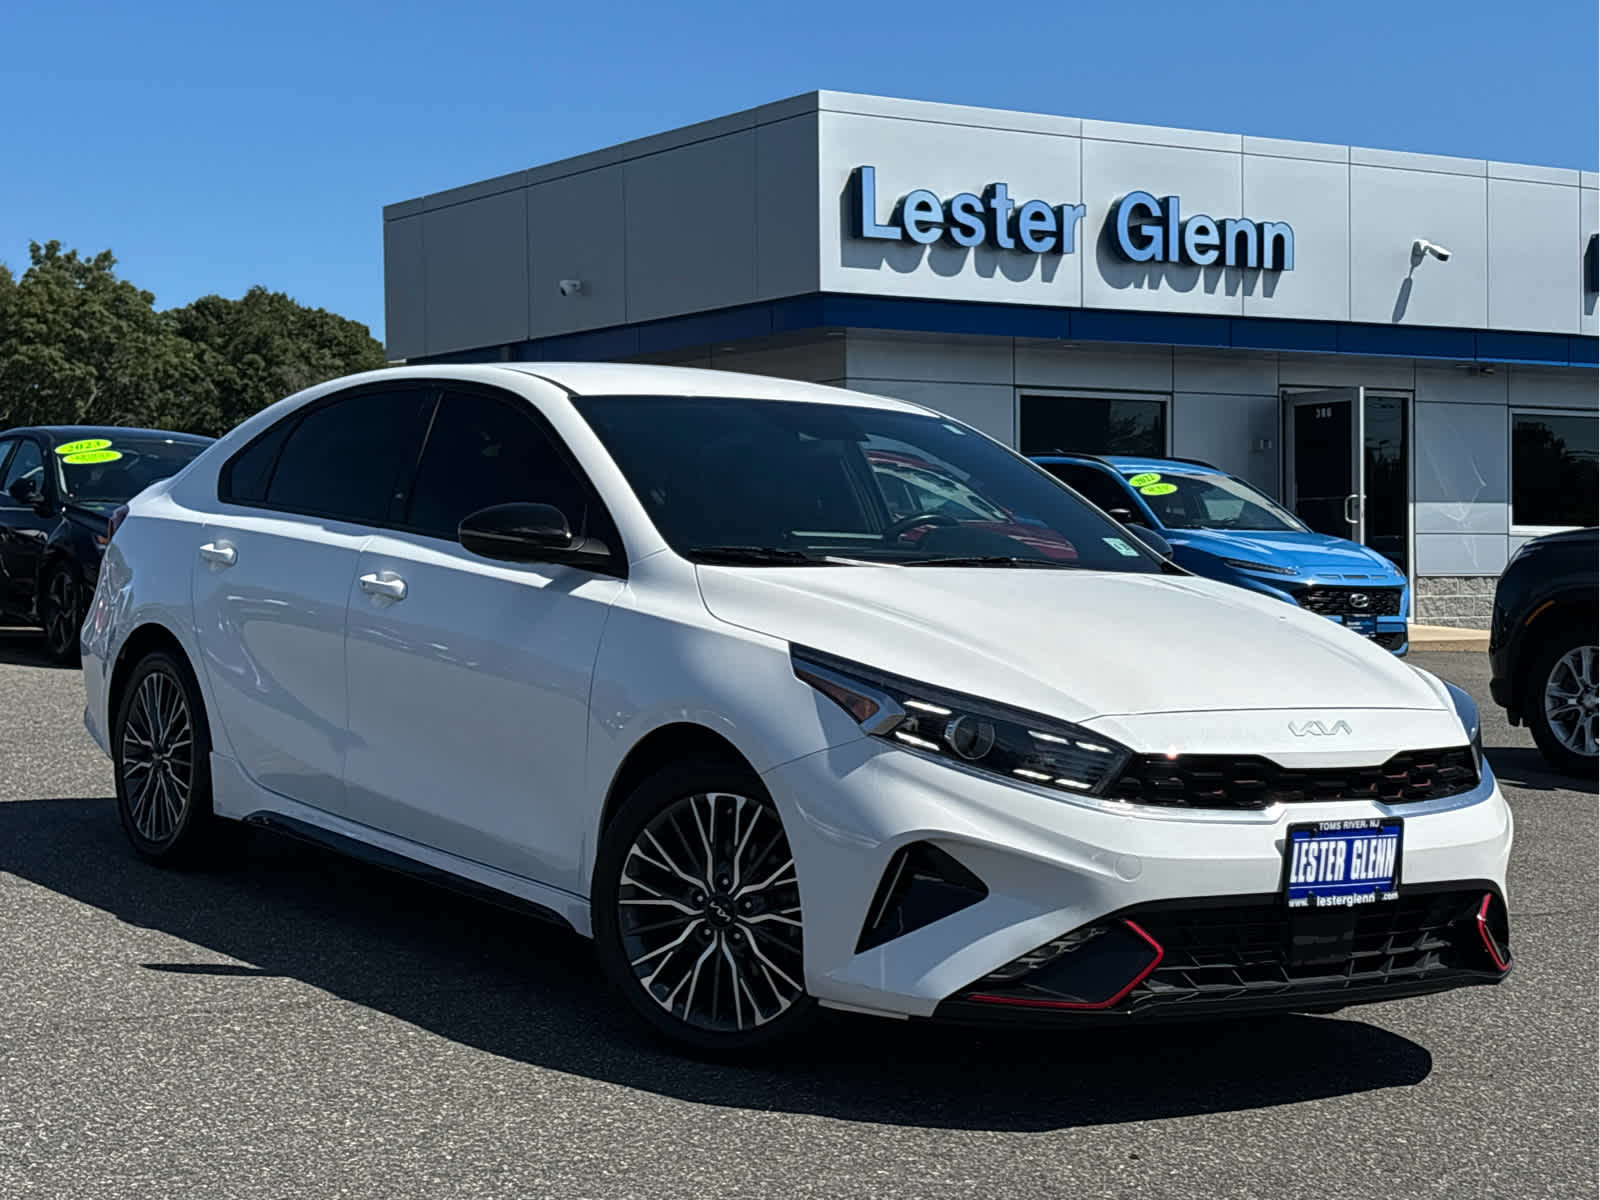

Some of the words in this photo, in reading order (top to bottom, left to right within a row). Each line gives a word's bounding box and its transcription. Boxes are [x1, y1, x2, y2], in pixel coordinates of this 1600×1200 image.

[854, 166, 1087, 255] Lester
[1110, 190, 1295, 272] Glenn
[1319, 822, 1341, 831] TOMS
[1369, 819, 1380, 828] NJ
[1289, 840, 1347, 884] LESTER
[1350, 837, 1397, 881] GLENN
[1316, 892, 1376, 908] lesterglenn
